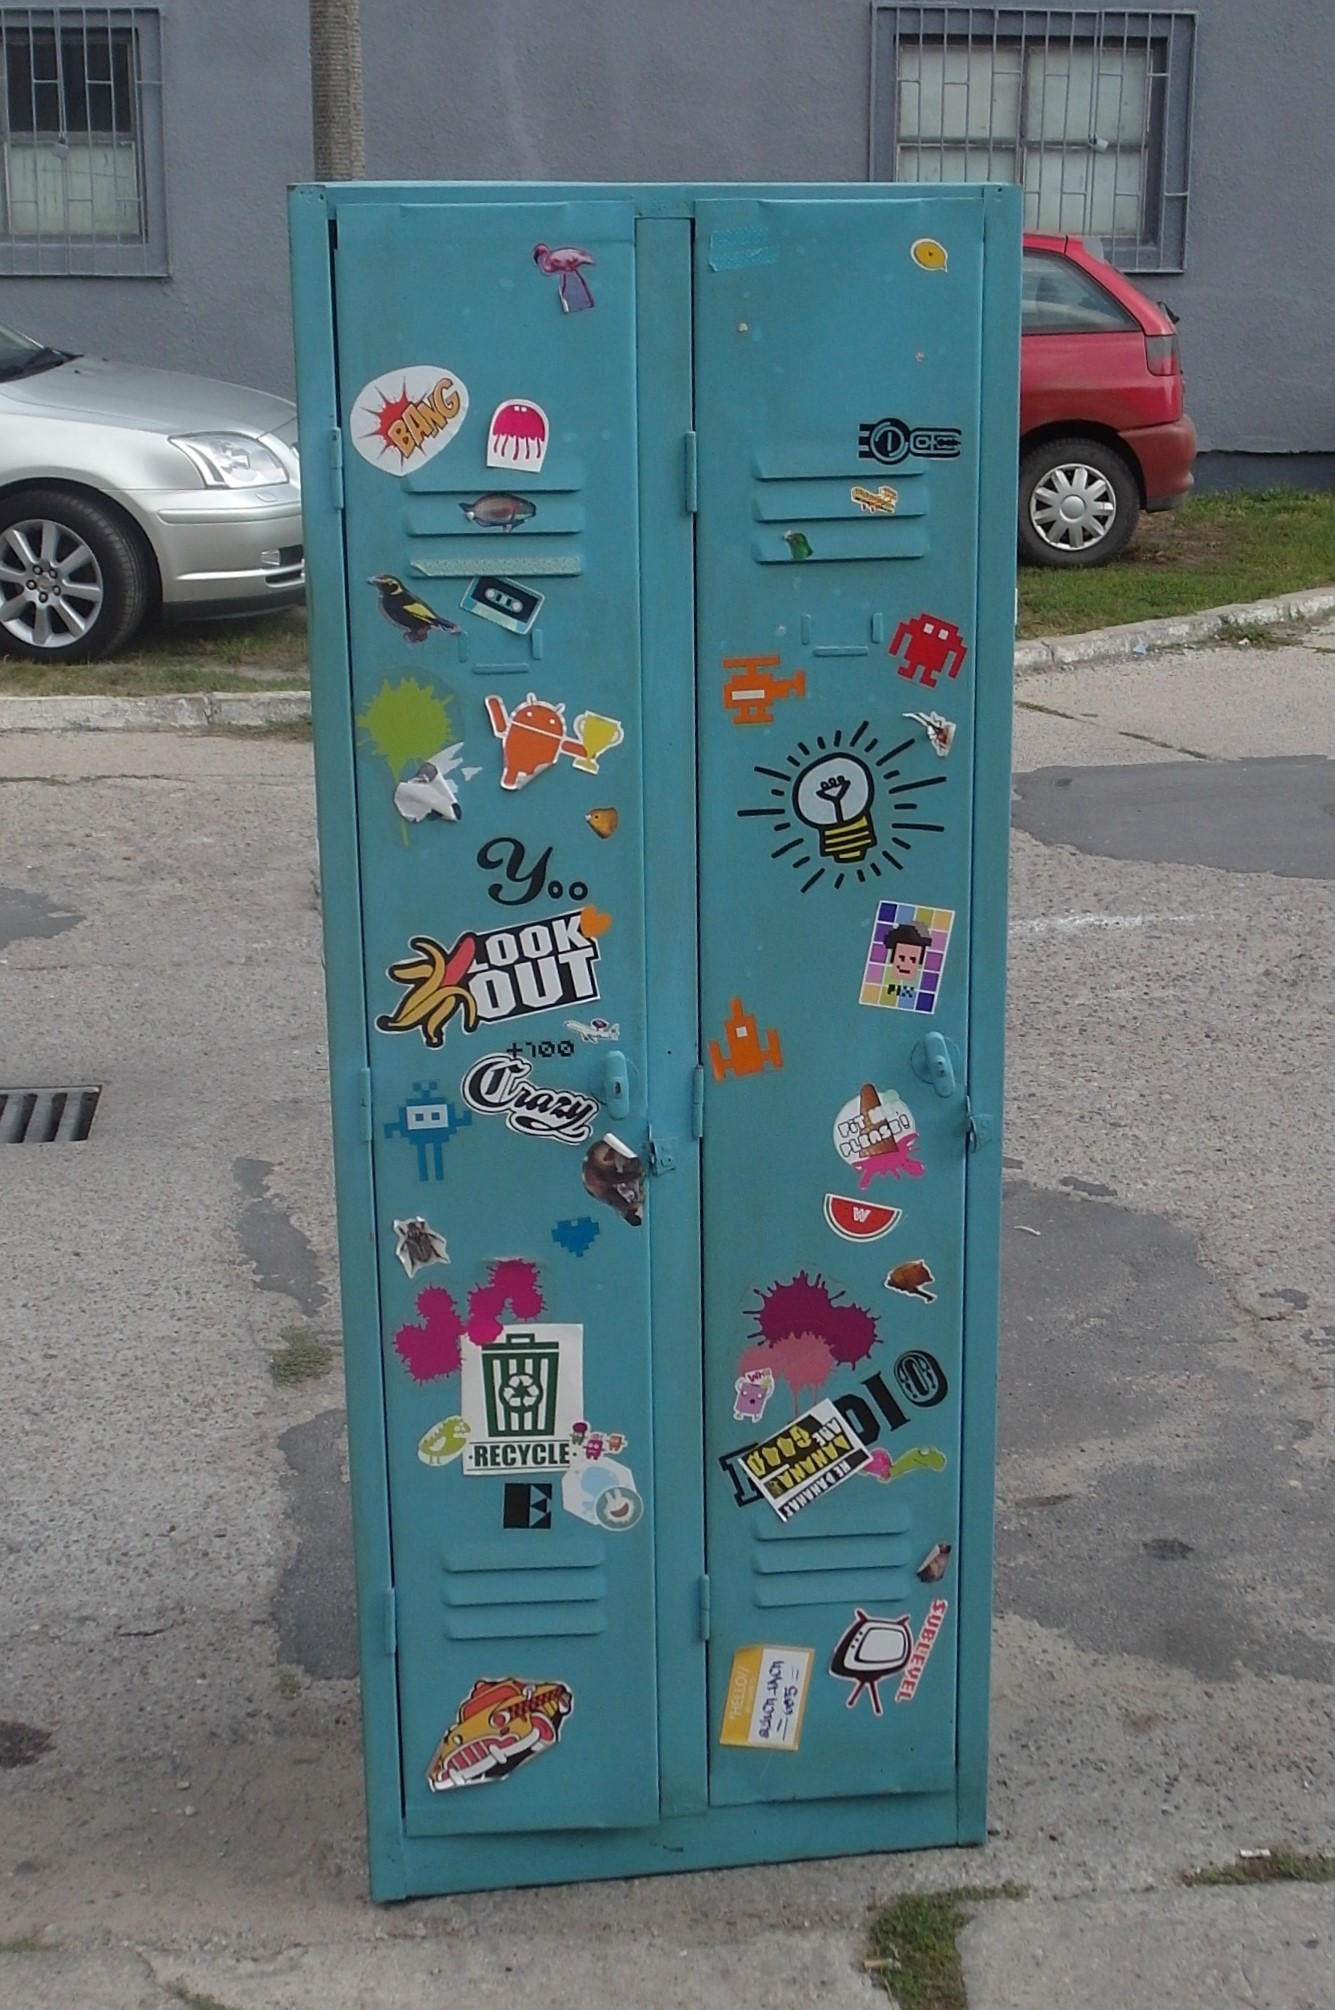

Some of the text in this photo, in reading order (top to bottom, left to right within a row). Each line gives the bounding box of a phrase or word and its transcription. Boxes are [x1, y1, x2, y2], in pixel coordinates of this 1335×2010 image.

[388, 378, 460, 459] BANG
[468, 947, 595, 1019] OUT
[466, 1058, 597, 1142] Crazy
[474, 1443, 570, 1467] RECYCLE
[719, 1350, 949, 1507] DIO
[896, 1600, 947, 1700] SUBLEVEL
